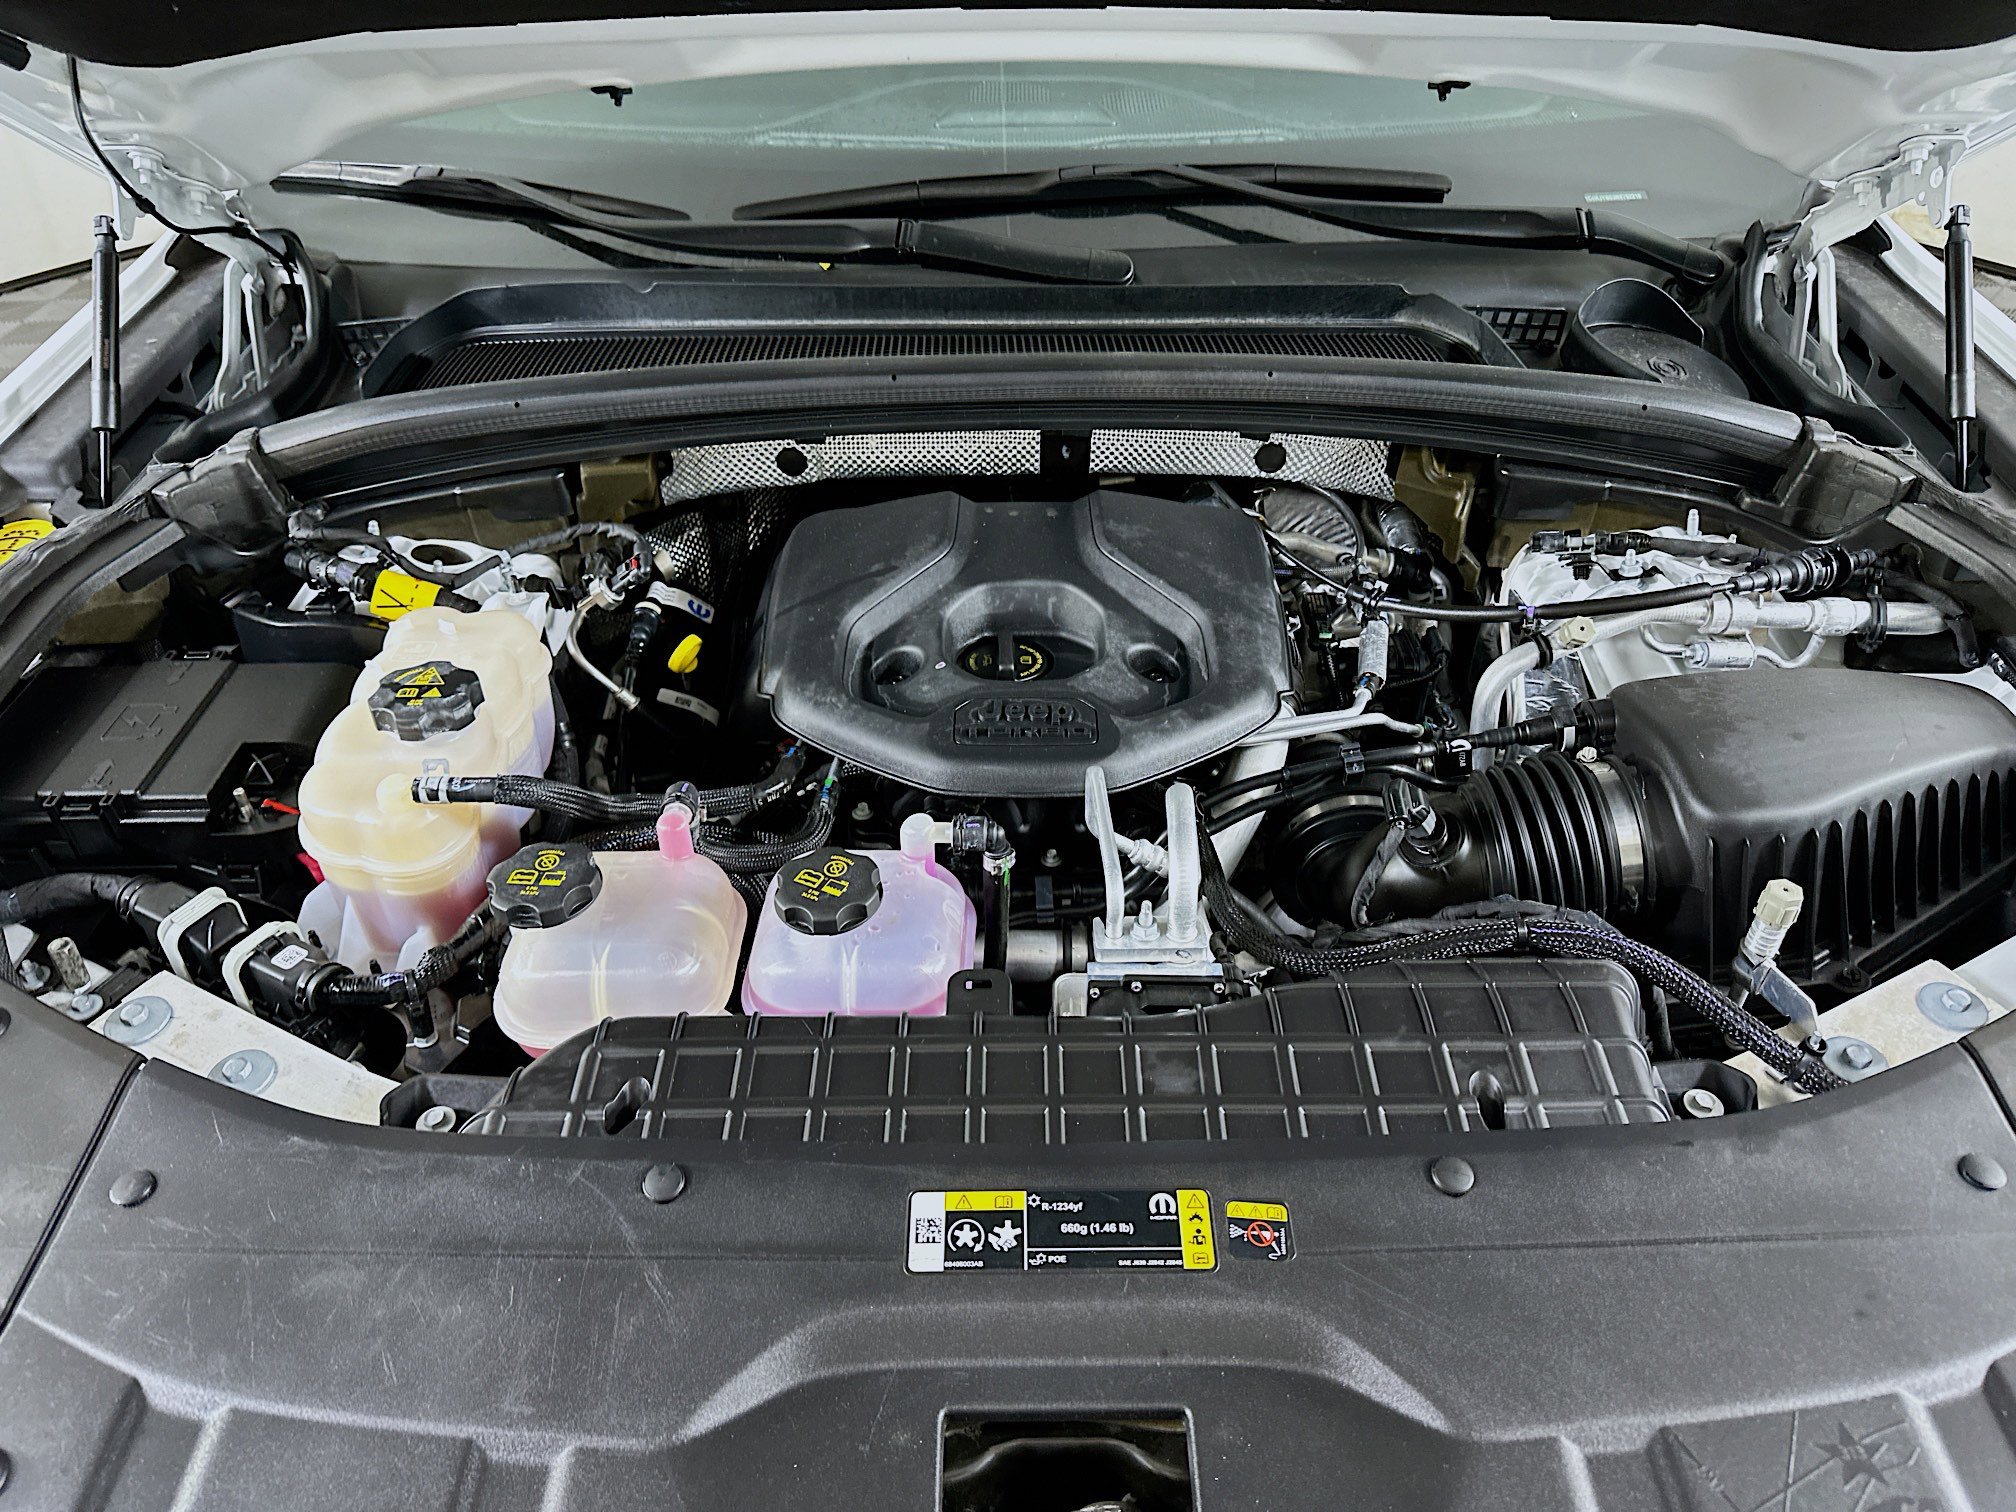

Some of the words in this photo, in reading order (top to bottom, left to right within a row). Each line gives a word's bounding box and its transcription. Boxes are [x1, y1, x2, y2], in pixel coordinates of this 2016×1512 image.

[976, 699, 1074, 726] Jeep
[1041, 1202, 1083, 1213] R-1234yf
[1060, 1223, 1088, 1235] 660g
[1089, 1222, 1117, 1235] (1.46
[1118, 1222, 1134, 1235] lb)
[1048, 1255, 1067, 1264] POE
